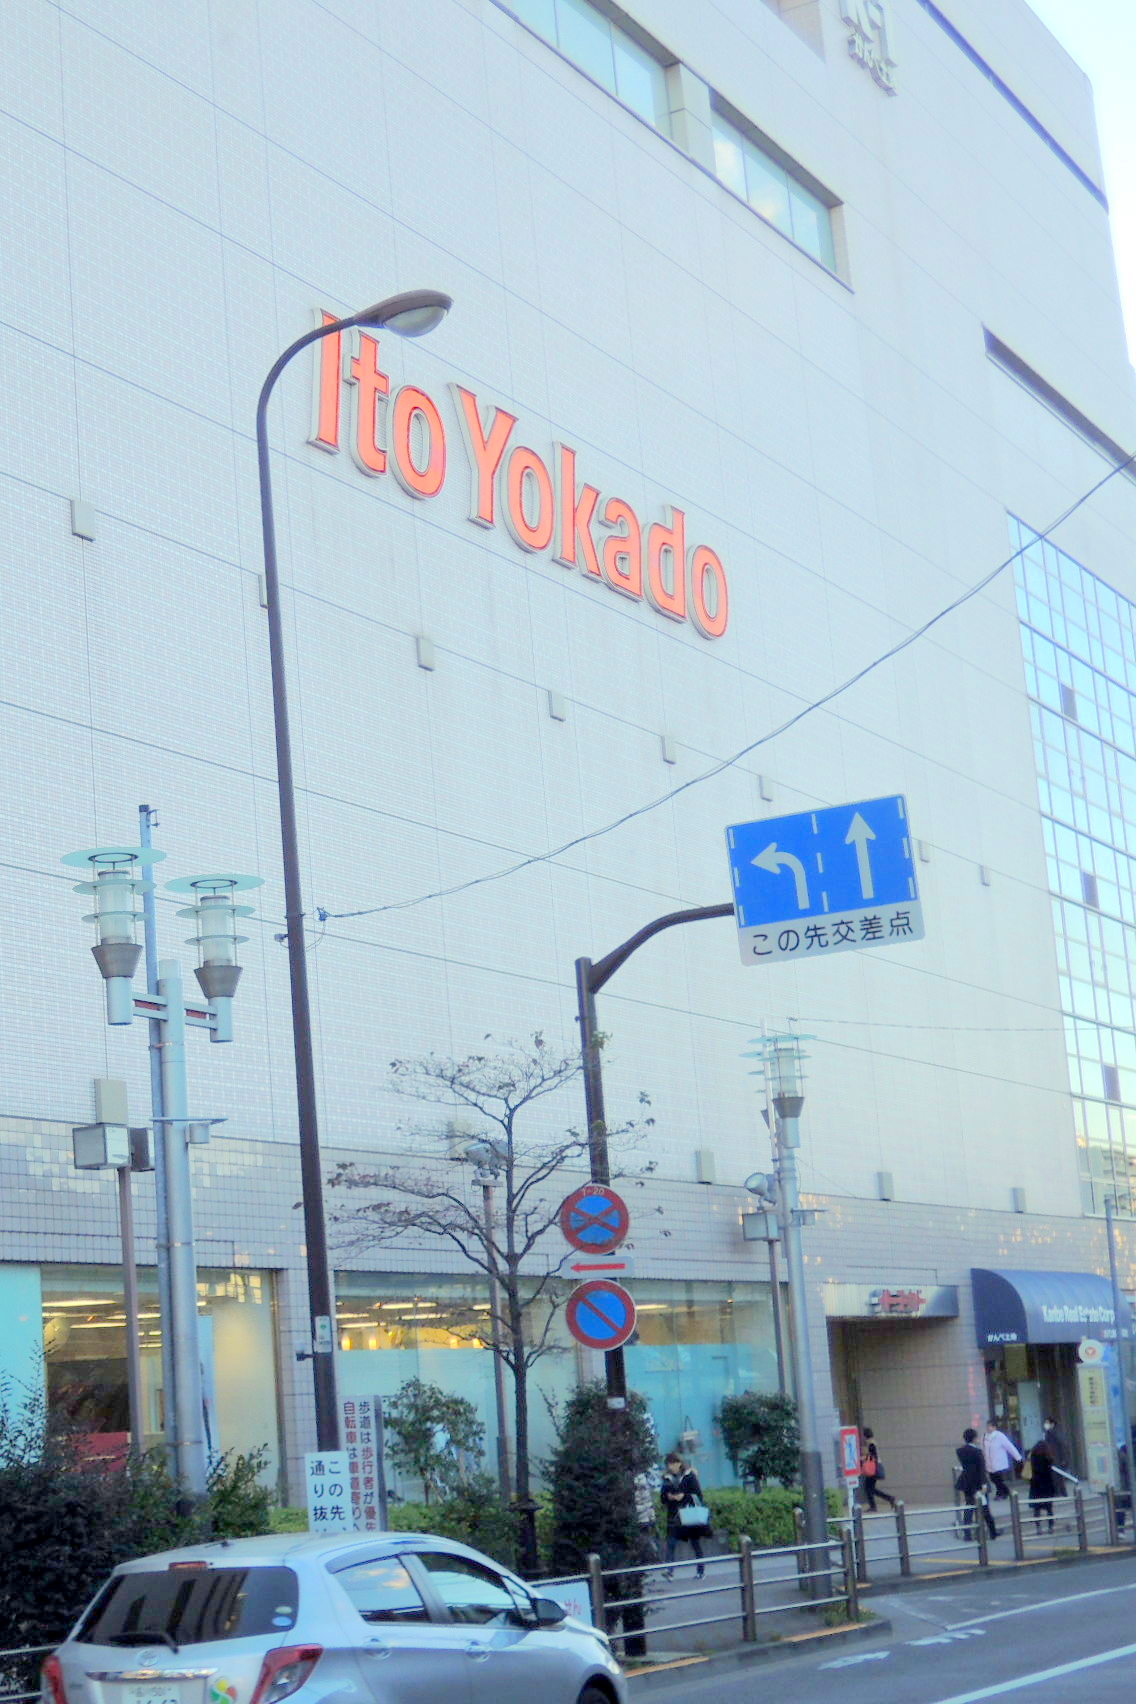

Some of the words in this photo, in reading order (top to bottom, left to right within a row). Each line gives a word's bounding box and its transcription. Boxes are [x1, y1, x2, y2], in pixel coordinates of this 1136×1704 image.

[308, 308, 447, 500] Ito
[448, 382, 730, 640] Yokado
[752, 911, 914, 957] この先交差点
[310, 1460, 329, 1532] 通り抜
